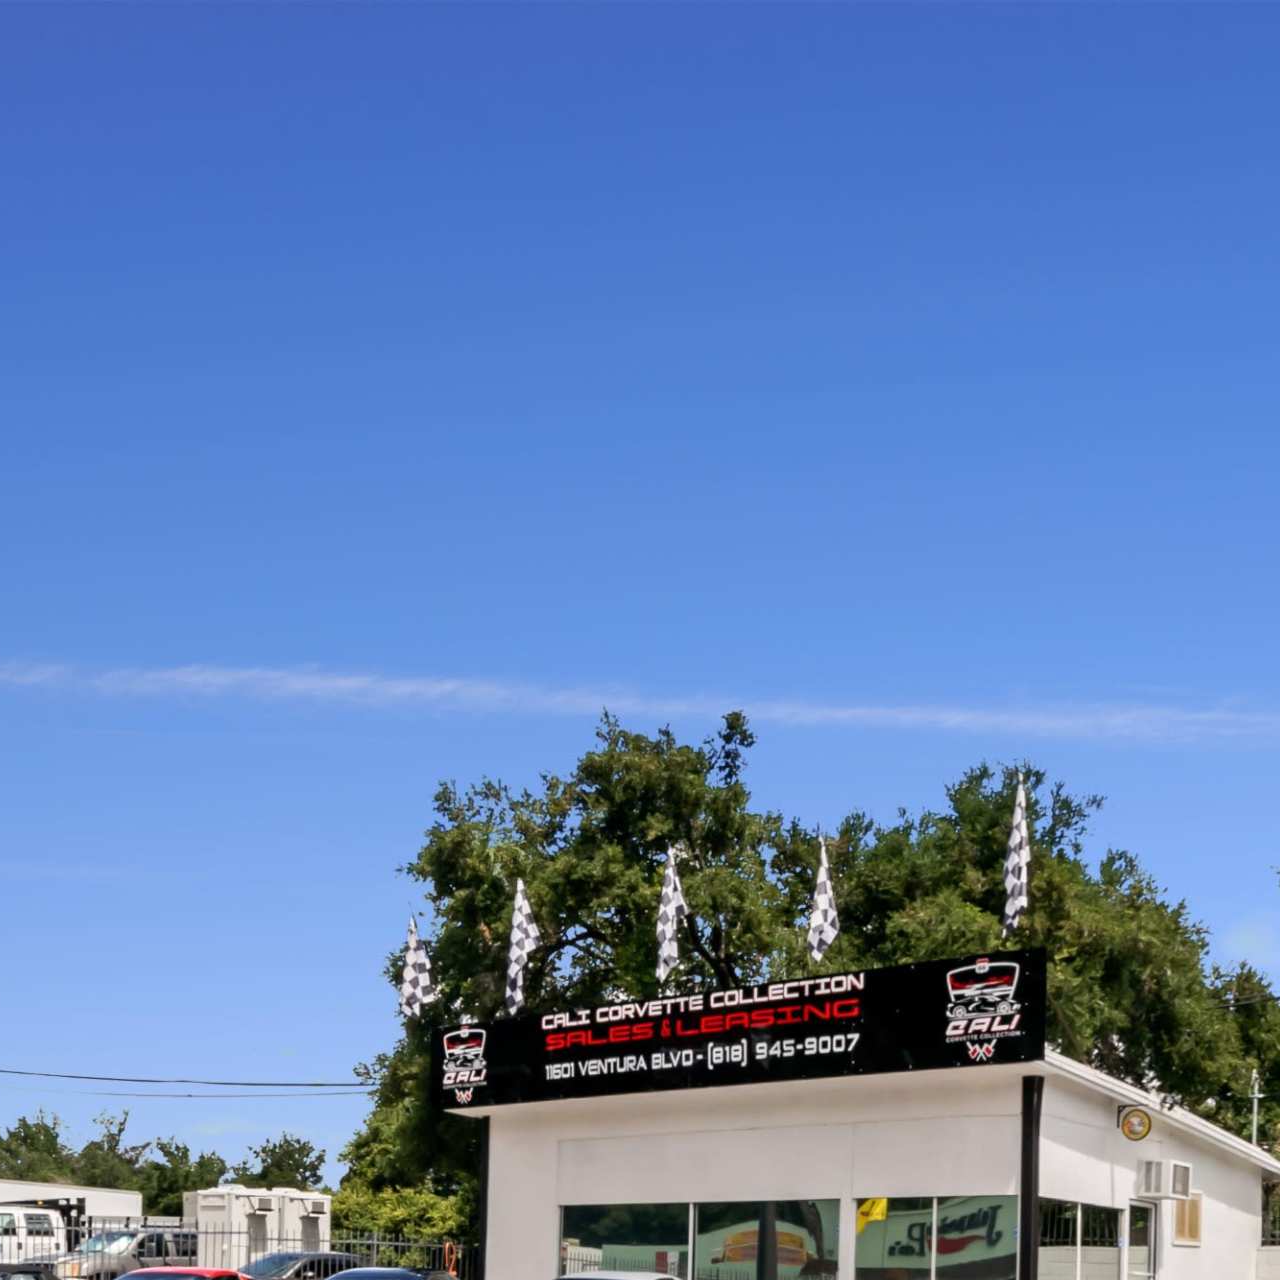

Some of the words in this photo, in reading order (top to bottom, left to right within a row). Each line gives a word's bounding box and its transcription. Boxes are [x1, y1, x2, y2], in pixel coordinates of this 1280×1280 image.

[541, 1008, 591, 1030] CALI
[596, 995, 704, 1023] CORVETTE
[710, 972, 865, 1009] COLLECTION
[544, 1021, 656, 1051] SALES
[660, 1017, 671, 1037] &
[675, 998, 861, 1037] LEASING
[945, 1014, 1021, 1036] CALI
[442, 1069, 487, 1085] CALI
[545, 1062, 575, 1081] 11601
[578, 1055, 648, 1077] VENTURA
[651, 1049, 694, 1070] BLVD
[707, 1038, 748, 1071] (818)
[755, 1033, 861, 1061] 945-9007
